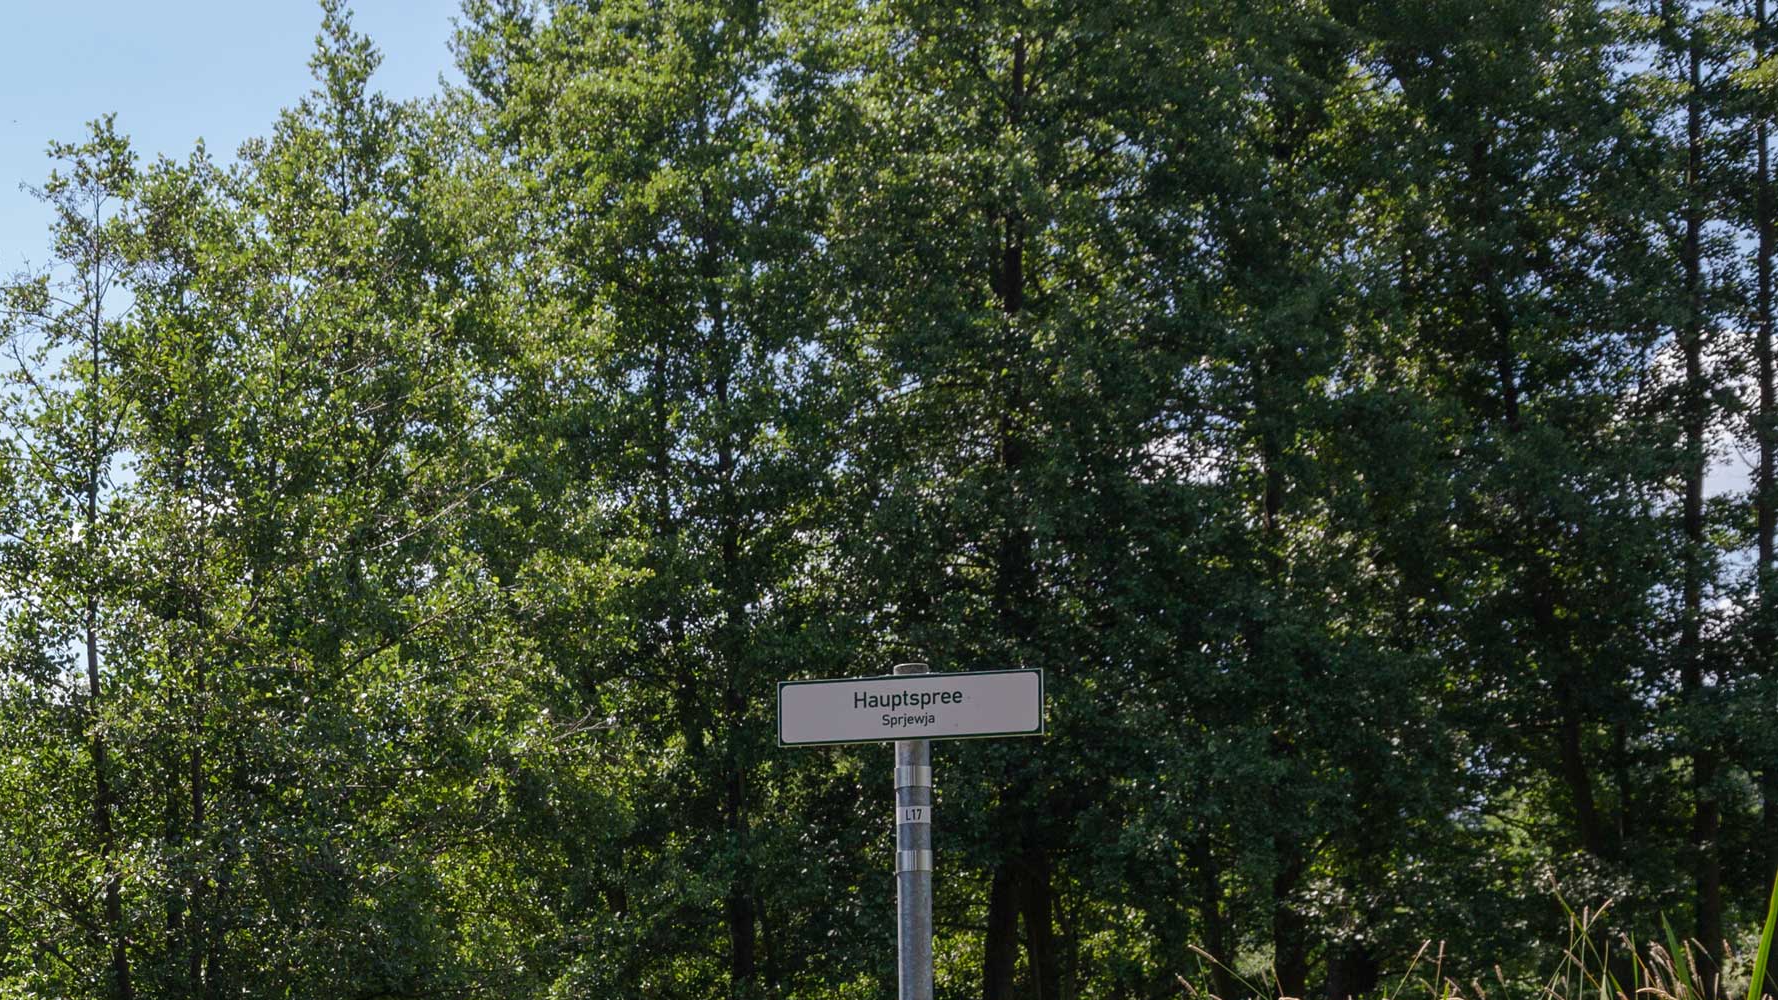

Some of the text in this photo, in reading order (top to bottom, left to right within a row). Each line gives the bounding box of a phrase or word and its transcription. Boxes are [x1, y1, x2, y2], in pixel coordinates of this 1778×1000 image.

[854, 690, 963, 711] Hauptspree
[882, 712, 935, 728] Sprjewja
[905, 808, 922, 820] L17
